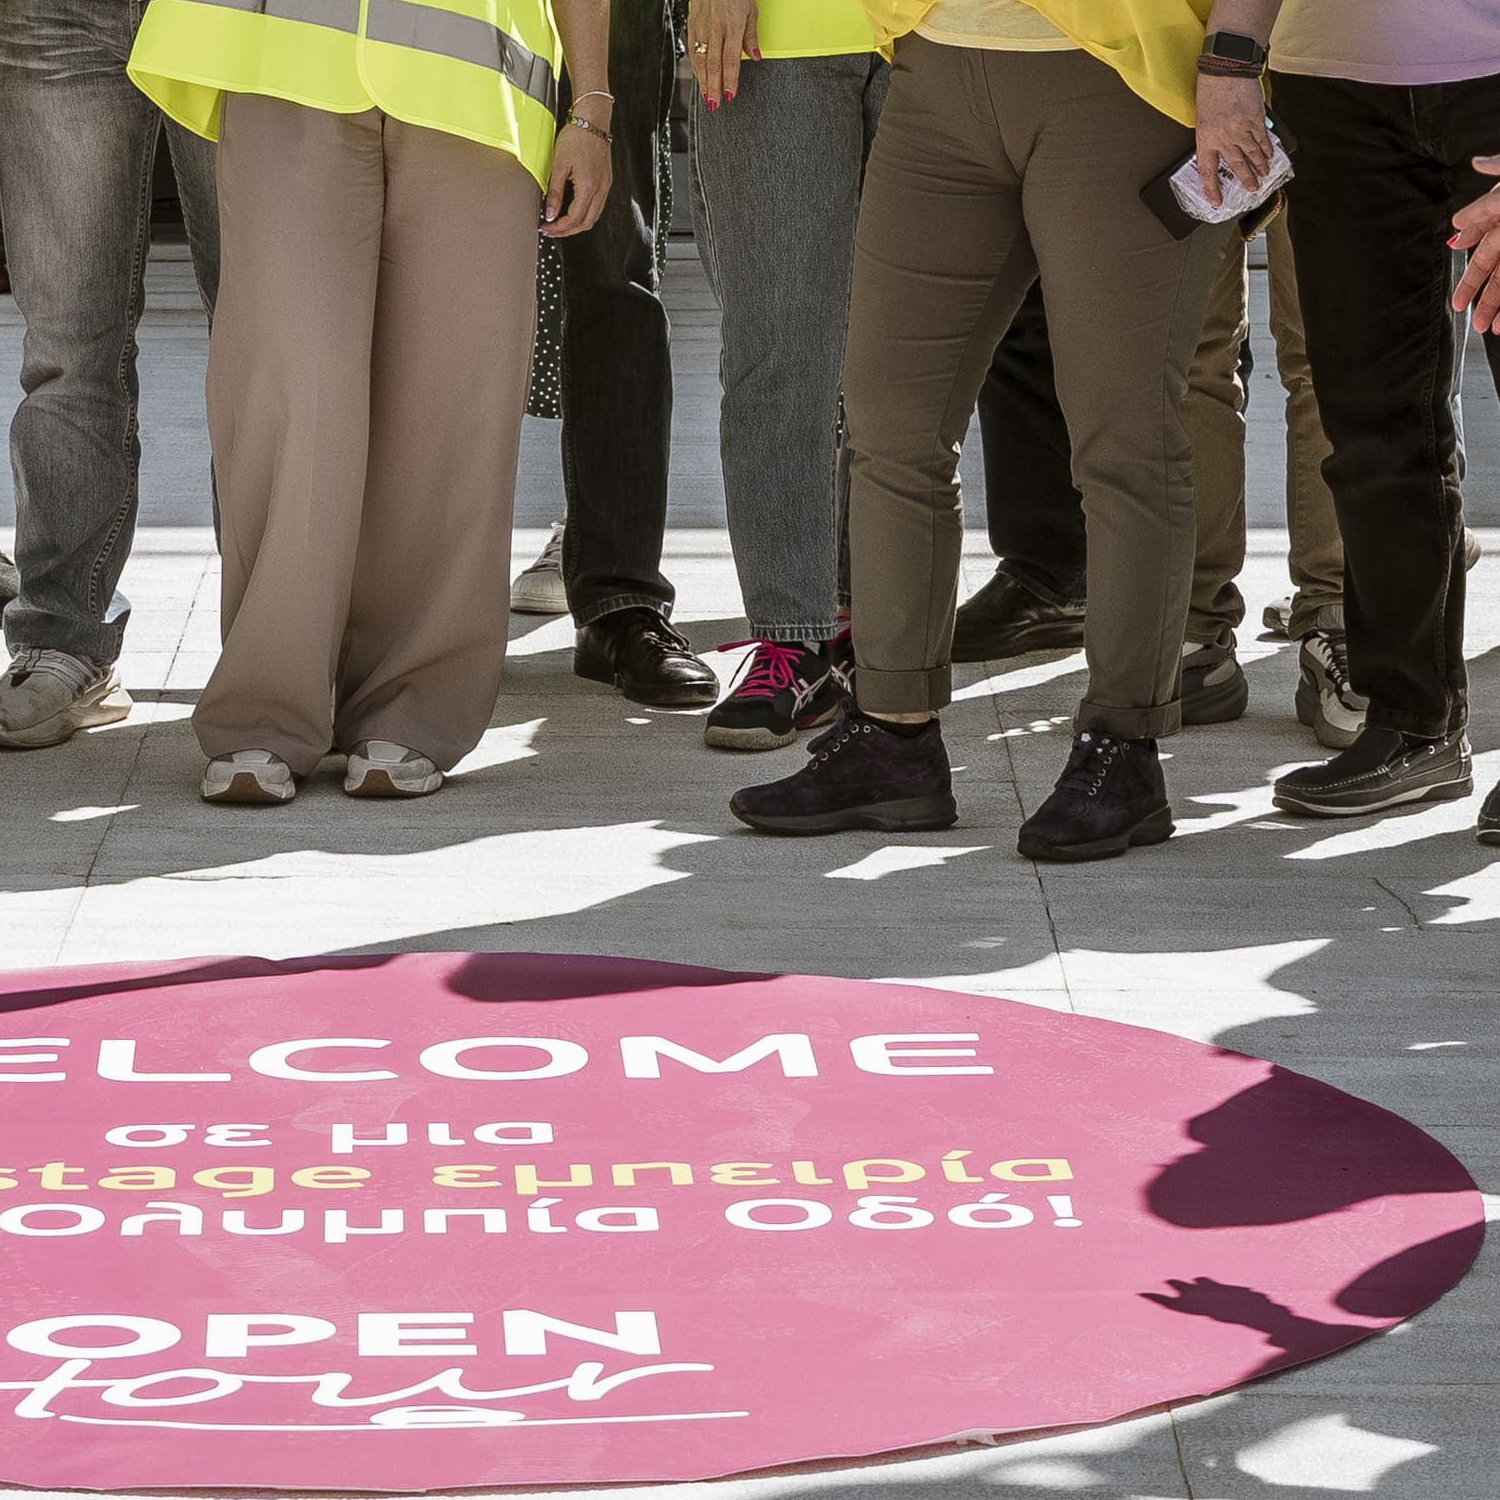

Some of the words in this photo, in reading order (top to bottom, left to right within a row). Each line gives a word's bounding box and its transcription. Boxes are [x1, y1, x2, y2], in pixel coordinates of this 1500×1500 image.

[105, 1123, 273, 1148] σε
[331, 1121, 554, 1154] μια
[432, 1150, 1075, 1196] εμπειρία
[724, 1192, 1084, 1233] Οδό!
[6, 1309, 662, 1359] OPEN
